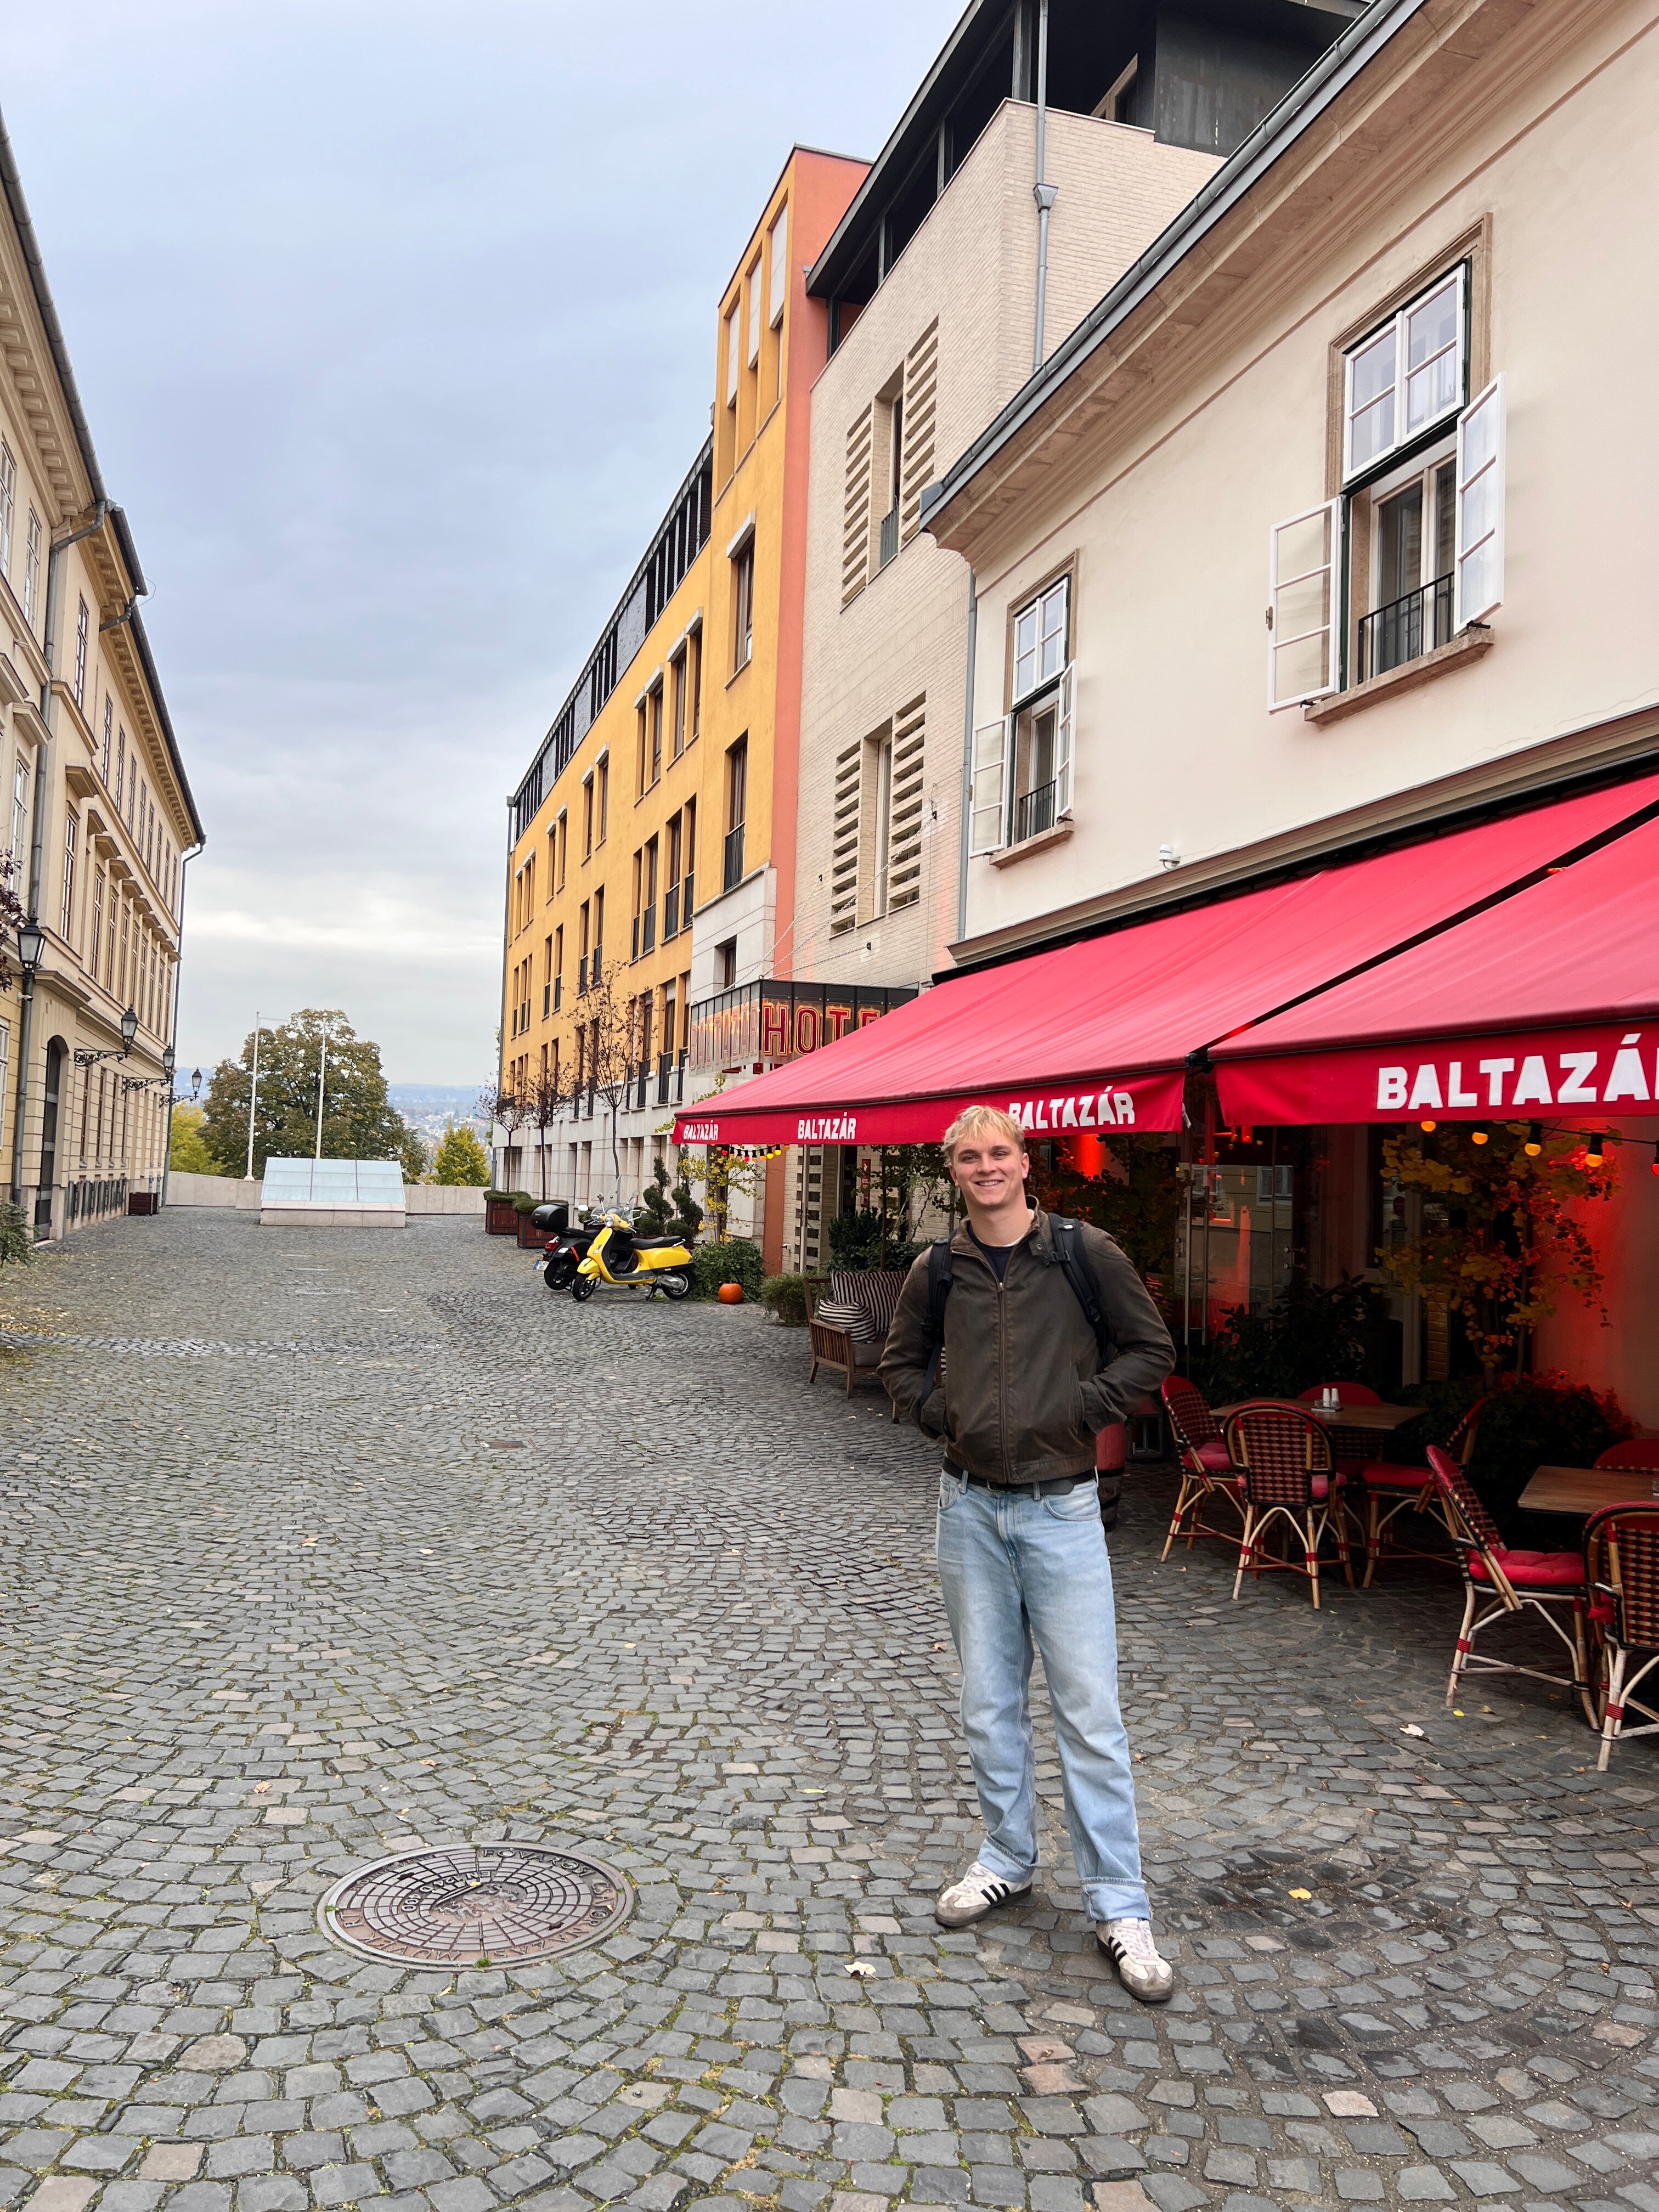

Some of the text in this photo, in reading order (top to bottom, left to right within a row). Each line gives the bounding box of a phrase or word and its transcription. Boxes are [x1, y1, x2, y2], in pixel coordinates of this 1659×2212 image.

[690, 990, 759, 1070] BALTAZÁR
[763, 1002, 894, 1057] HOT
[1376, 1032, 1659, 1110] BALTAZÁ
[683, 1119, 719, 1141] BALTAZÁR
[797, 1111, 857, 1140] BALTAZÁR
[1008, 1085, 1135, 1131] BALTAZÁR
